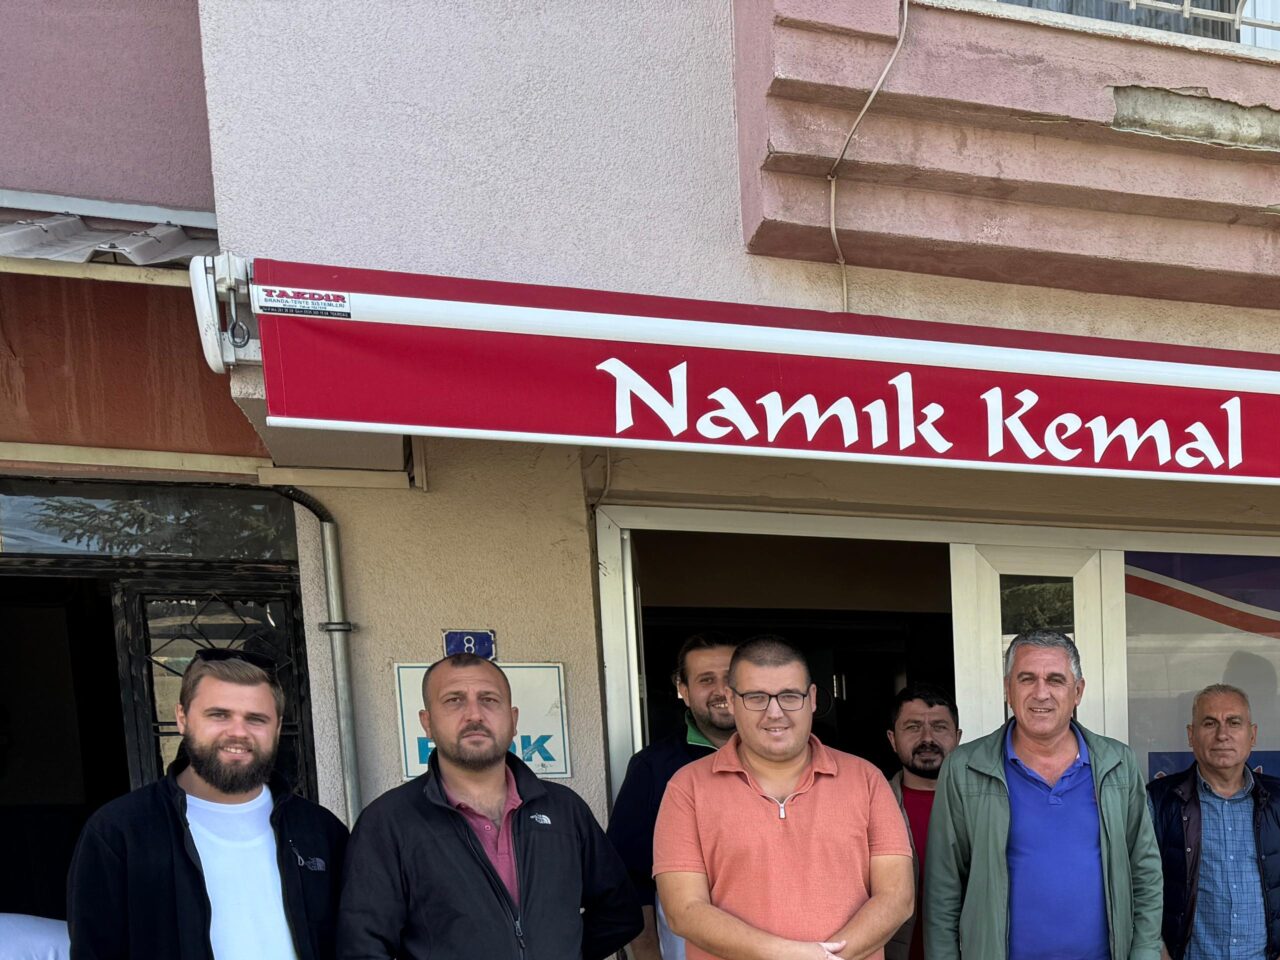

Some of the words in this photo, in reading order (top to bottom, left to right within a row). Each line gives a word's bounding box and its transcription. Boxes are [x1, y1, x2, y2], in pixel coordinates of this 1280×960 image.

[596, 358, 954, 454] Namık
[979, 386, 1243, 470] Kemal
[463, 636, 475, 654] 8
